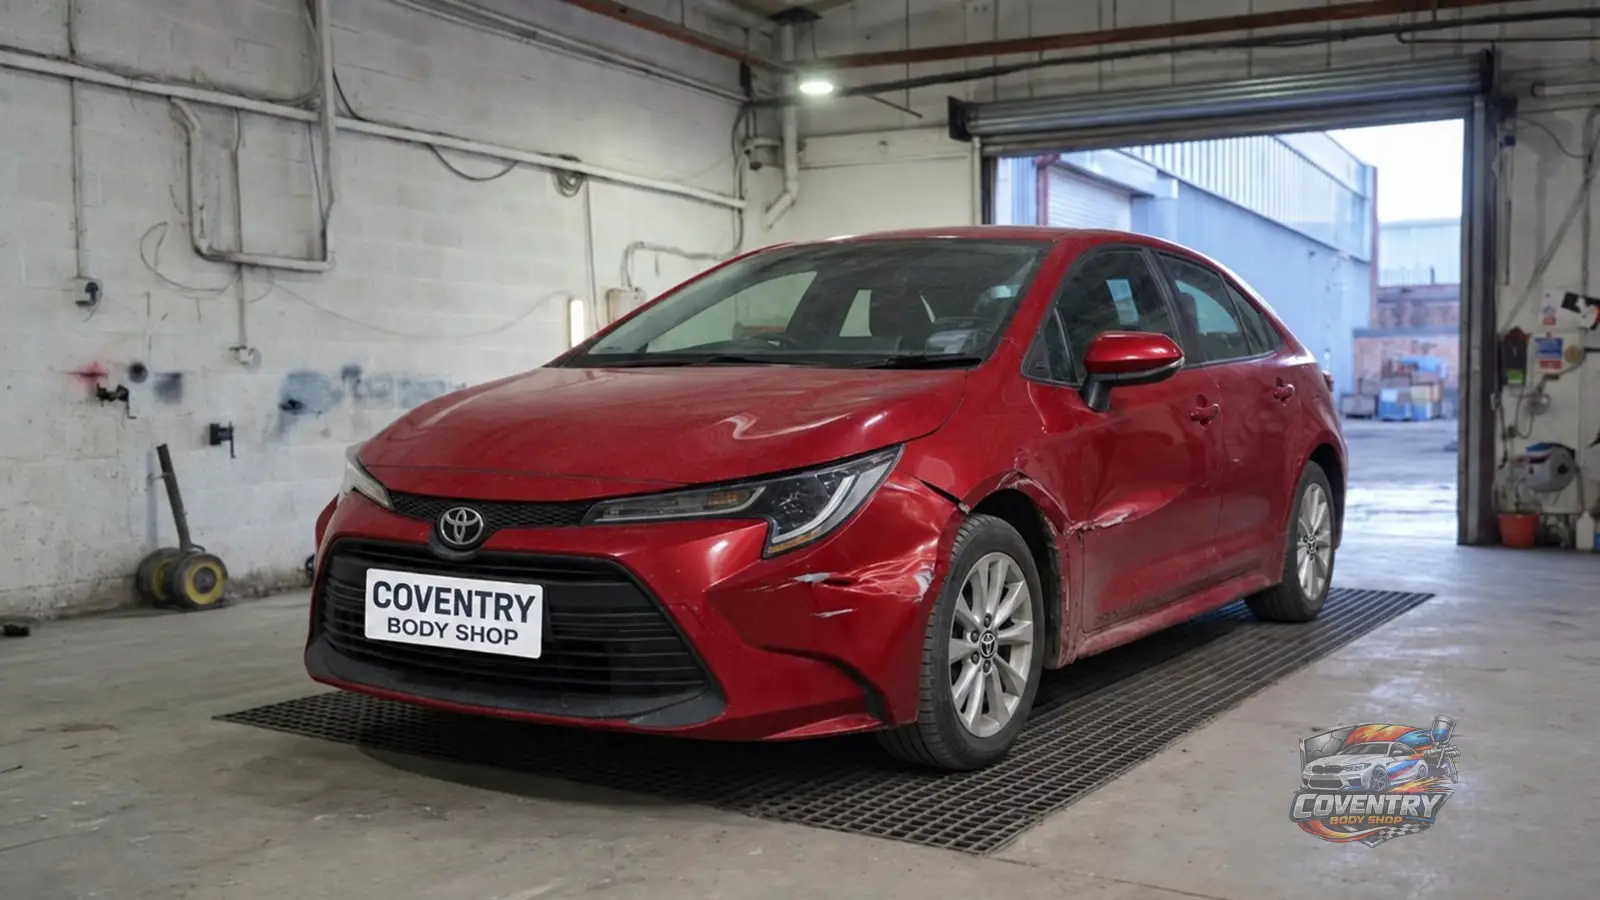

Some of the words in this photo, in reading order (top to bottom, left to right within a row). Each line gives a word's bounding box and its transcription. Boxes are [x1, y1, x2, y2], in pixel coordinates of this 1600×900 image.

[372, 580, 536, 623] COVENTRY
[387, 617, 449, 639] BODY
[455, 624, 518, 645] SHOP
